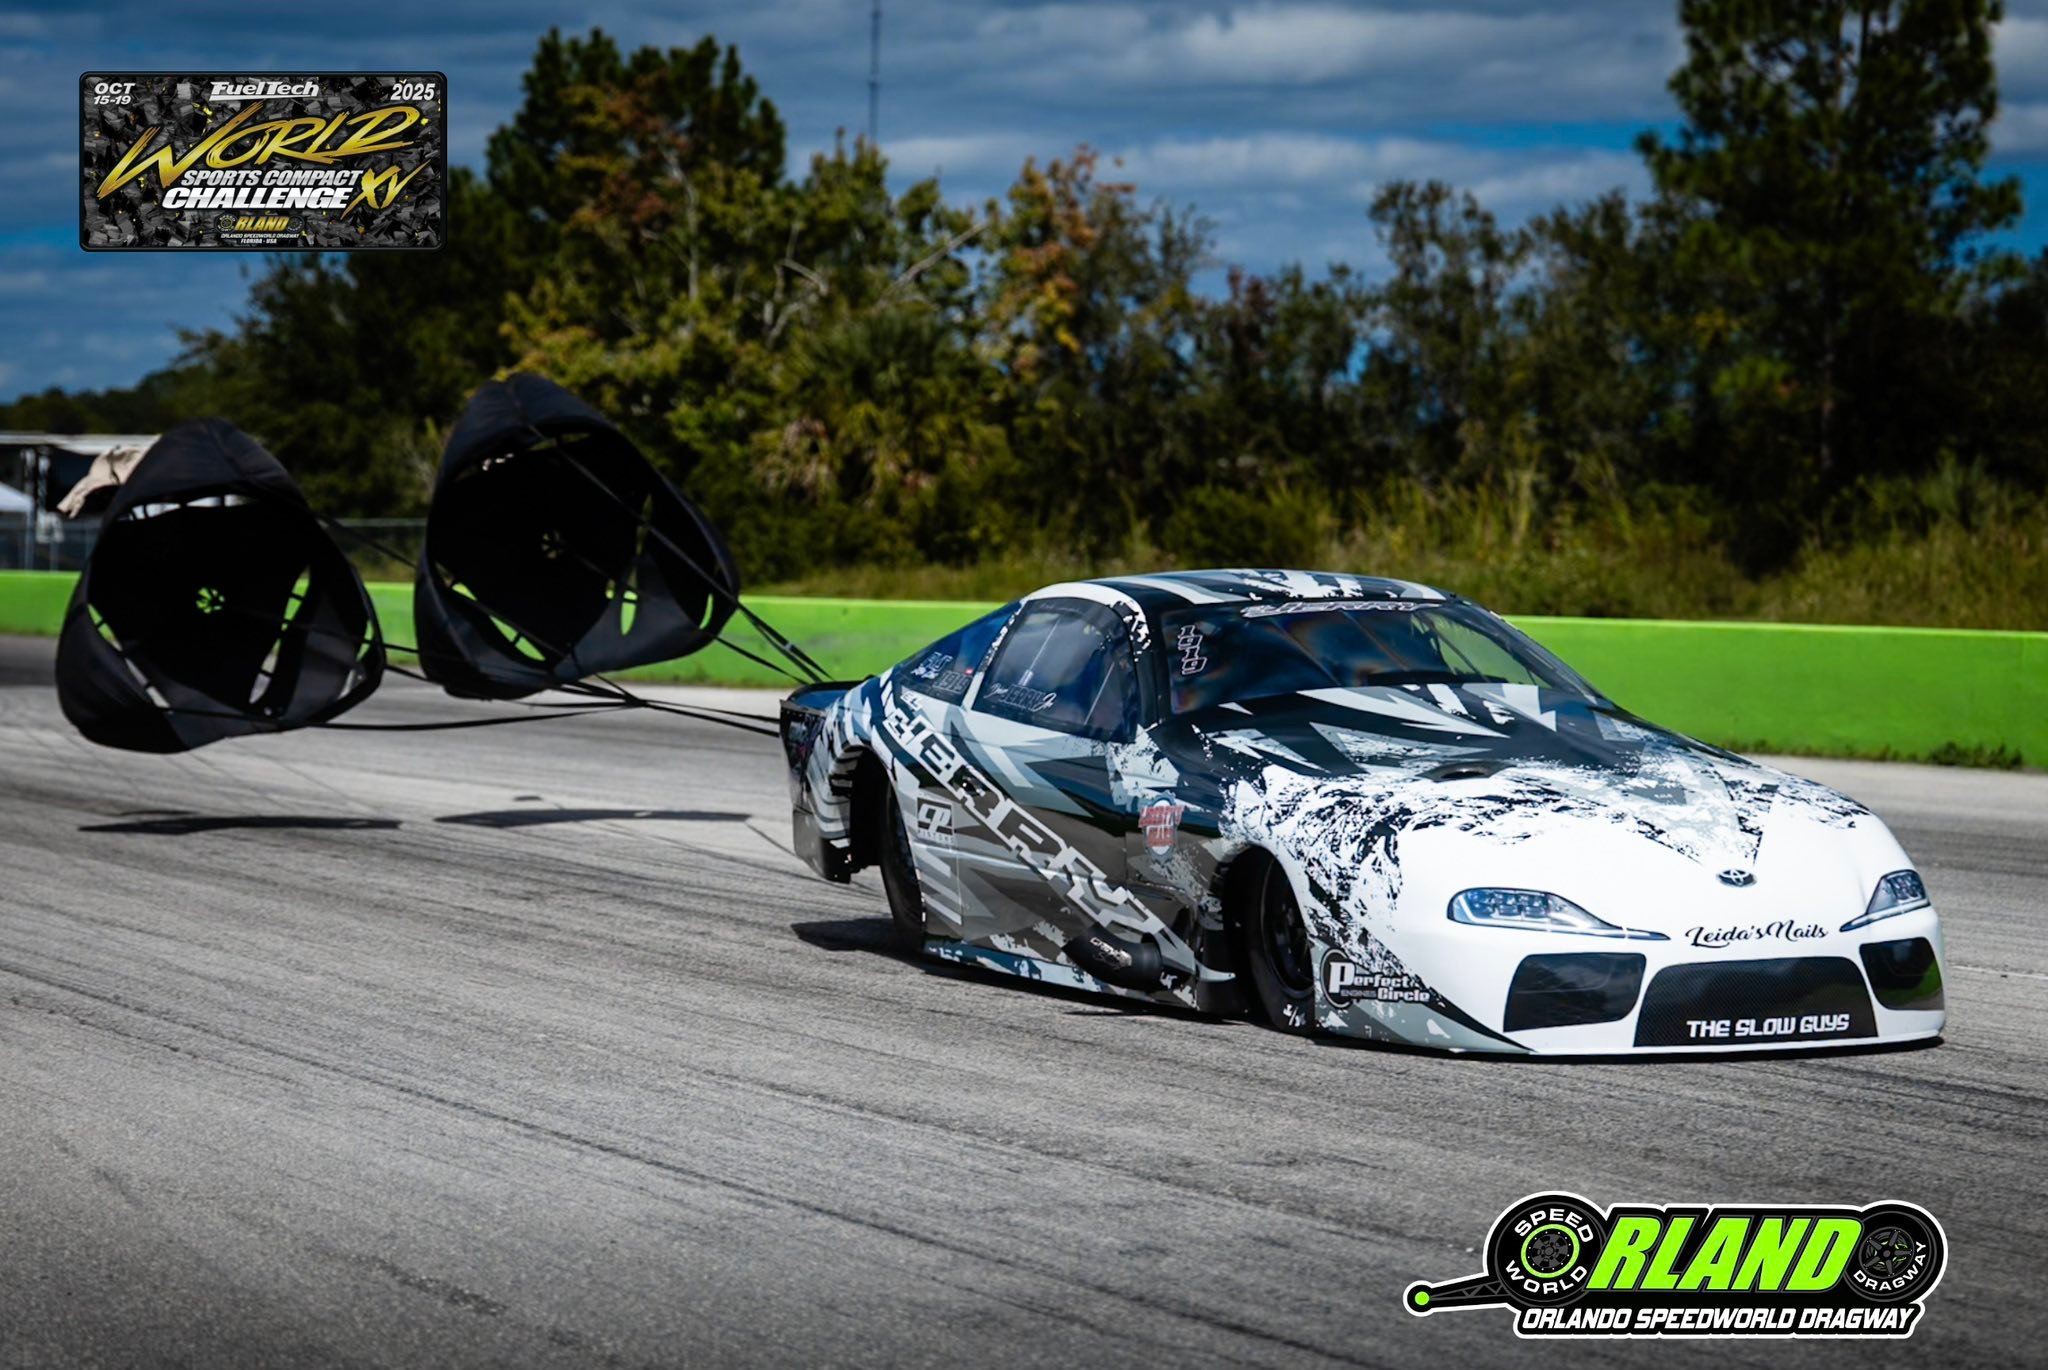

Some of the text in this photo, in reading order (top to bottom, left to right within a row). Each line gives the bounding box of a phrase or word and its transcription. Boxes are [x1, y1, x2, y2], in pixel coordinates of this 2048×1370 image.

[1177, 625, 1208, 675] 1919
[1329, 961, 1409, 993] Perfect
[1377, 987, 1430, 1001] Circle
[1687, 1014, 1850, 1038] THE SLOW GUYS
